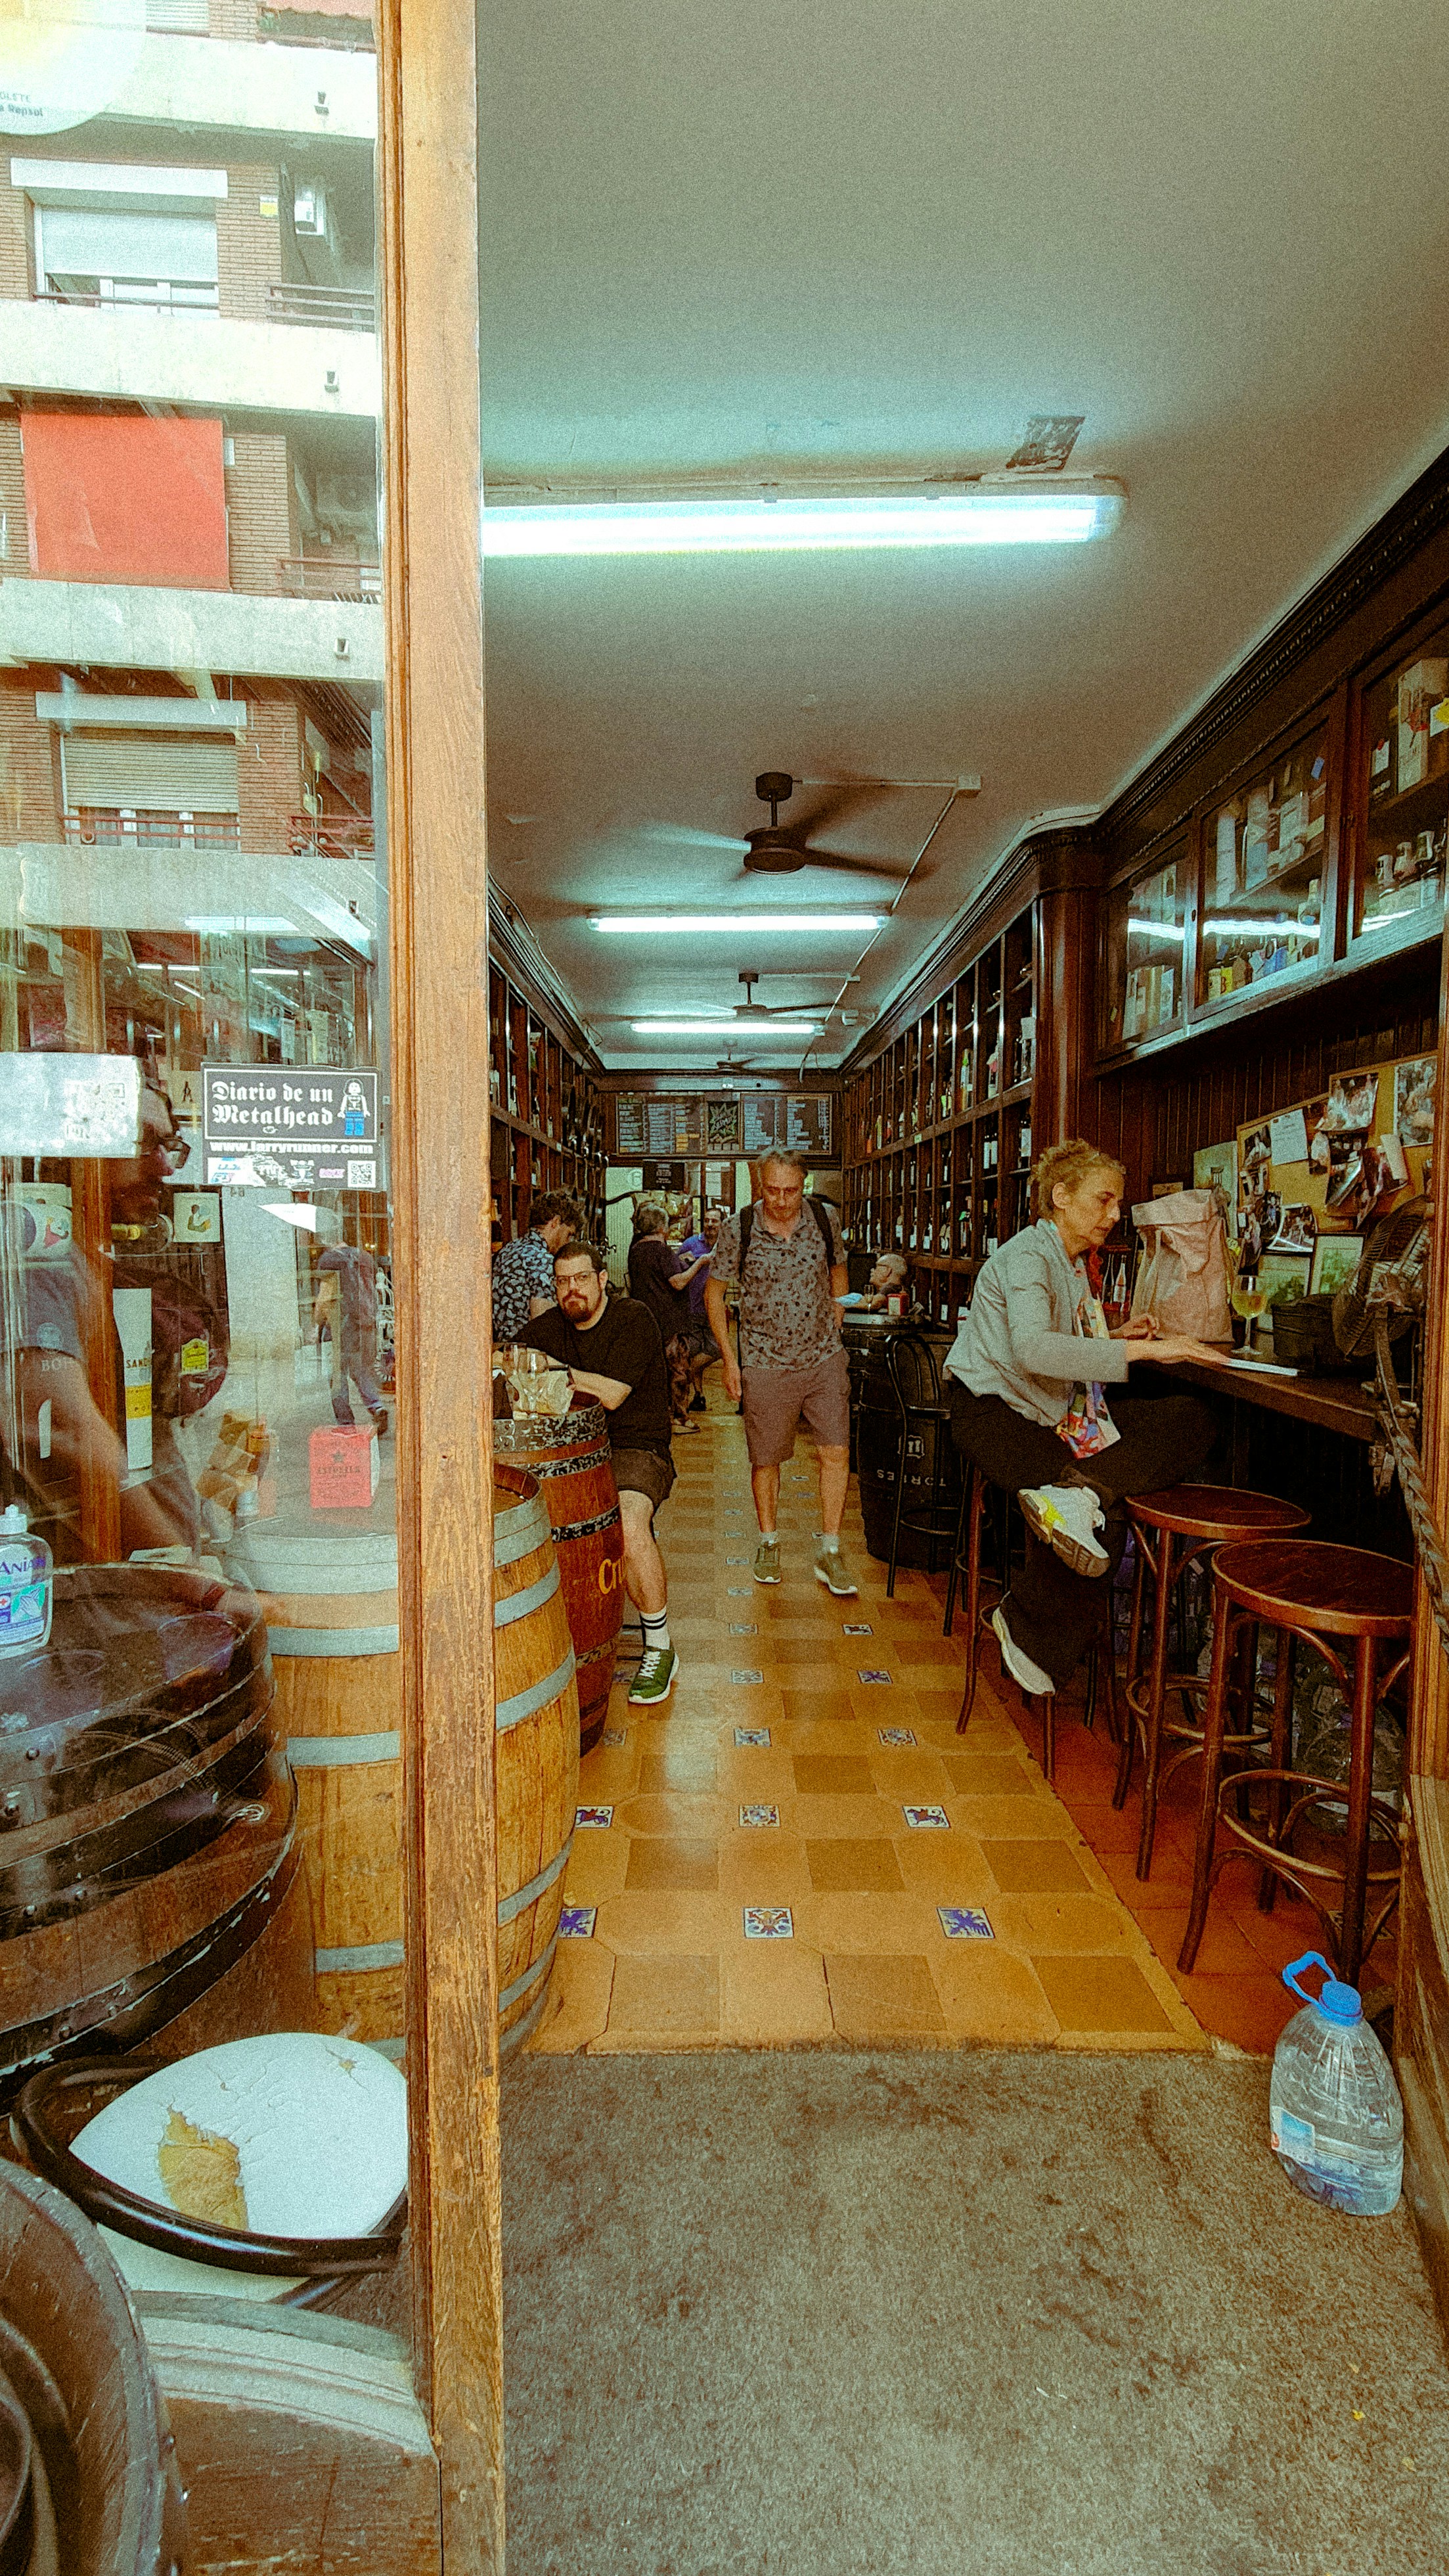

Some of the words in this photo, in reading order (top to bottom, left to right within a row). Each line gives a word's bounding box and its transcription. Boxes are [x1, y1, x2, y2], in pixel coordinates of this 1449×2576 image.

[8, 103, 43, 116] Repsol
[212, 1081, 277, 1102] Diario
[282, 1082, 303, 1102] de
[309, 1087, 334, 1103] un
[212, 1104, 334, 1131] Metalhead
[209, 1141, 374, 1154] www.larryrunner.com
